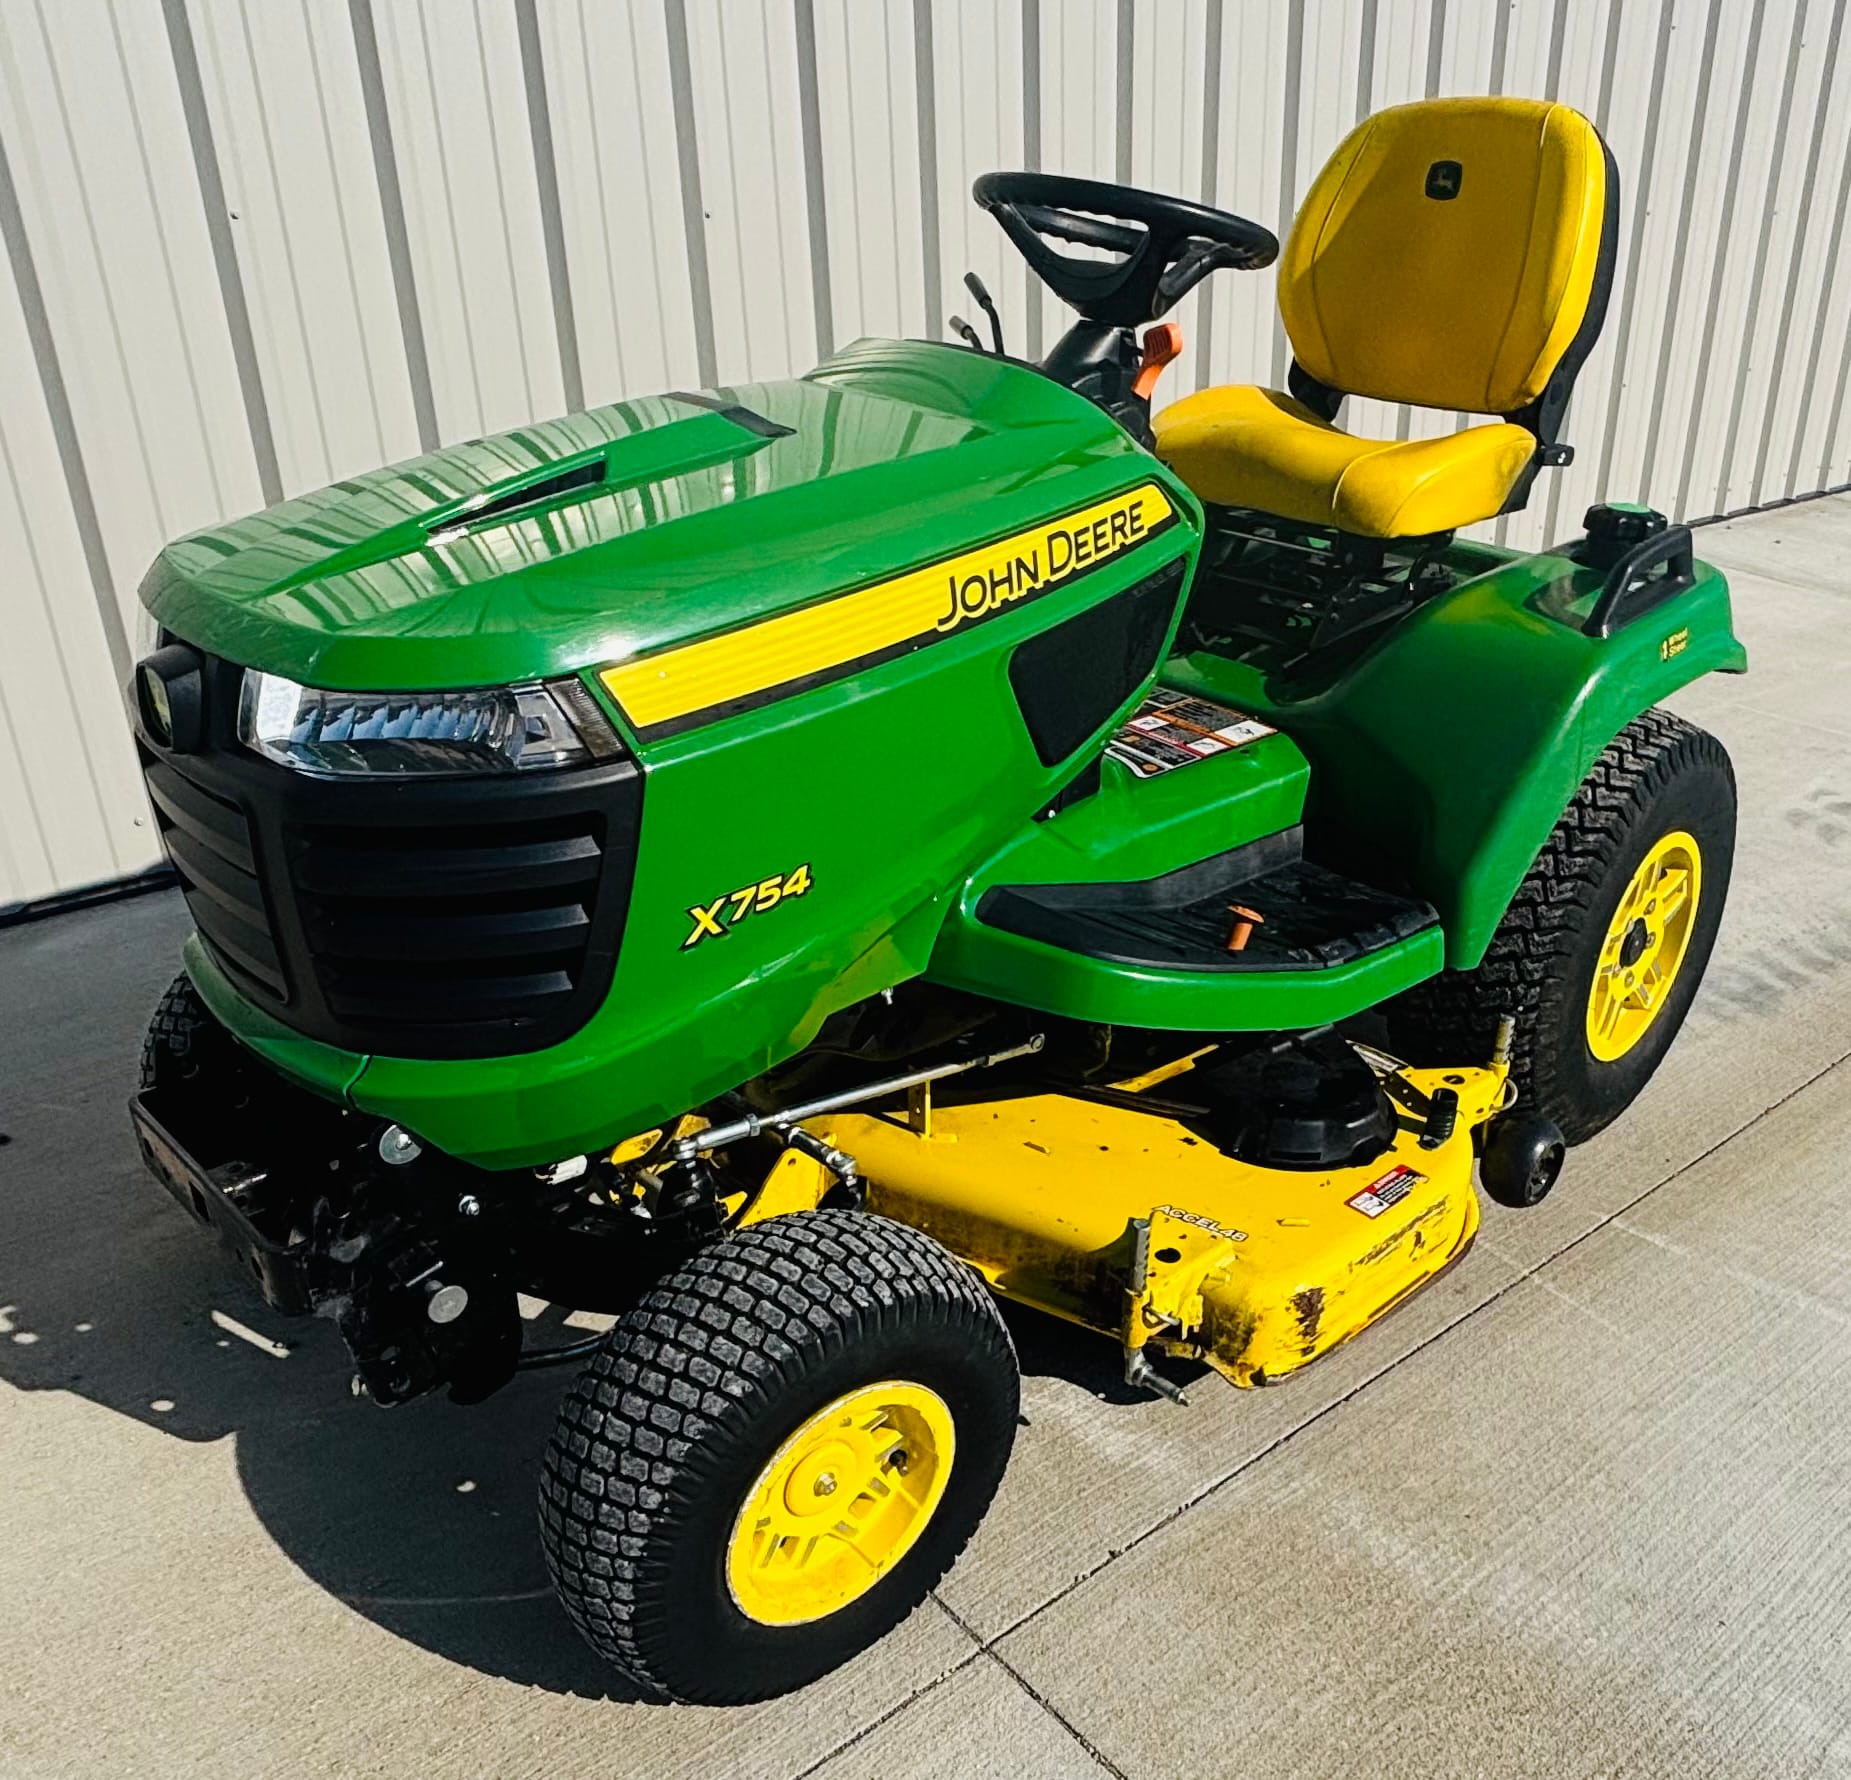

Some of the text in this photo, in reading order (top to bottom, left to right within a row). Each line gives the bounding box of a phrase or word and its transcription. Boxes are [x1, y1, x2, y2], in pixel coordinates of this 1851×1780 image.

[936, 549, 1040, 629] JOHN
[1046, 499, 1146, 577] DEERE
[681, 863, 813, 950] X754
